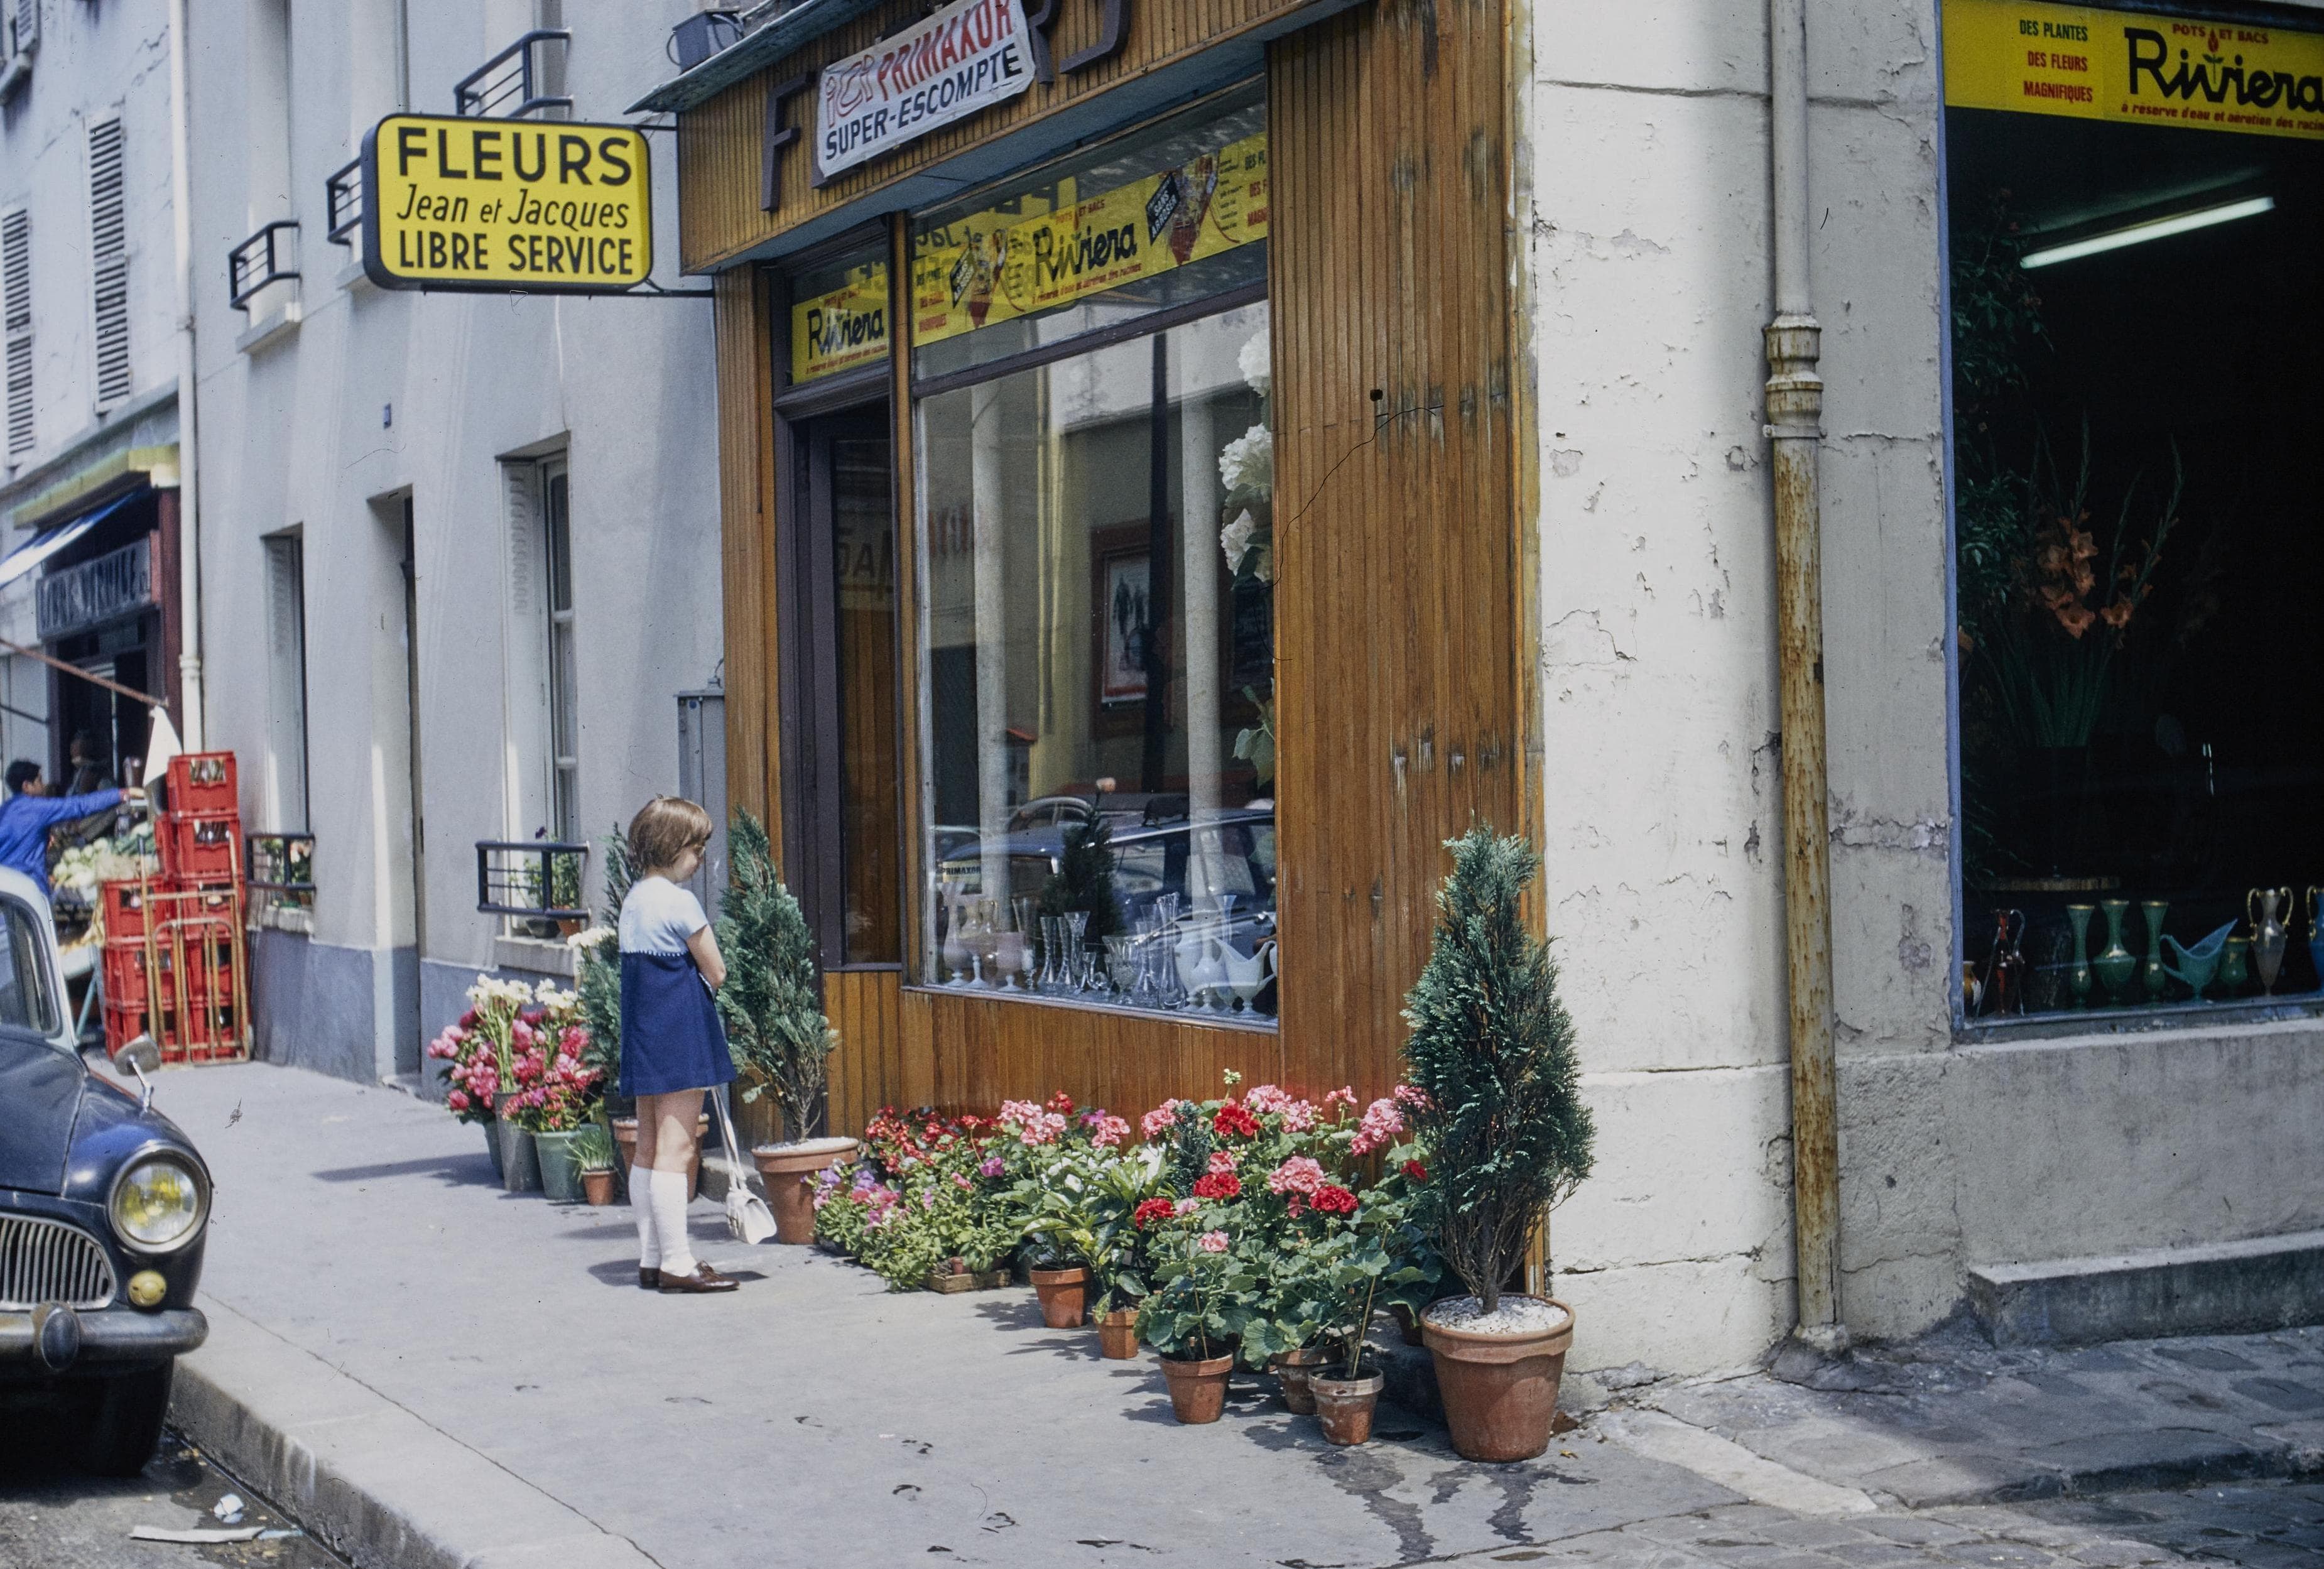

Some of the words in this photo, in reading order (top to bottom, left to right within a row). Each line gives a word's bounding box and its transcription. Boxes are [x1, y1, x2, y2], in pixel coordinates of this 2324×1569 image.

[2019, 19, 2039, 36] DES
[2043, 22, 2088, 41] PLANTES
[2172, 23, 2206, 37] POTS
[2219, 28, 2233, 40] ET
[2237, 30, 2269, 45] BACS
[2028, 50, 2046, 68] DES
[2051, 53, 2088, 72] FLEURS
[2124, 26, 2324, 112] Riviera
[825, 42, 1023, 160] SUPER-ESCOMPTE
[2023, 80, 2093, 105] MAGNIFIQUES
[398, 126, 632, 186] FLEURS
[396, 183, 469, 223] Jean
[480, 195, 502, 223] et
[508, 188, 630, 232] Jacques
[399, 230, 489, 270] LIBRE
[508, 234, 633, 275] SERVICE
[1033, 222, 1138, 287] Riviera
[807, 308, 884, 360] Riviera
